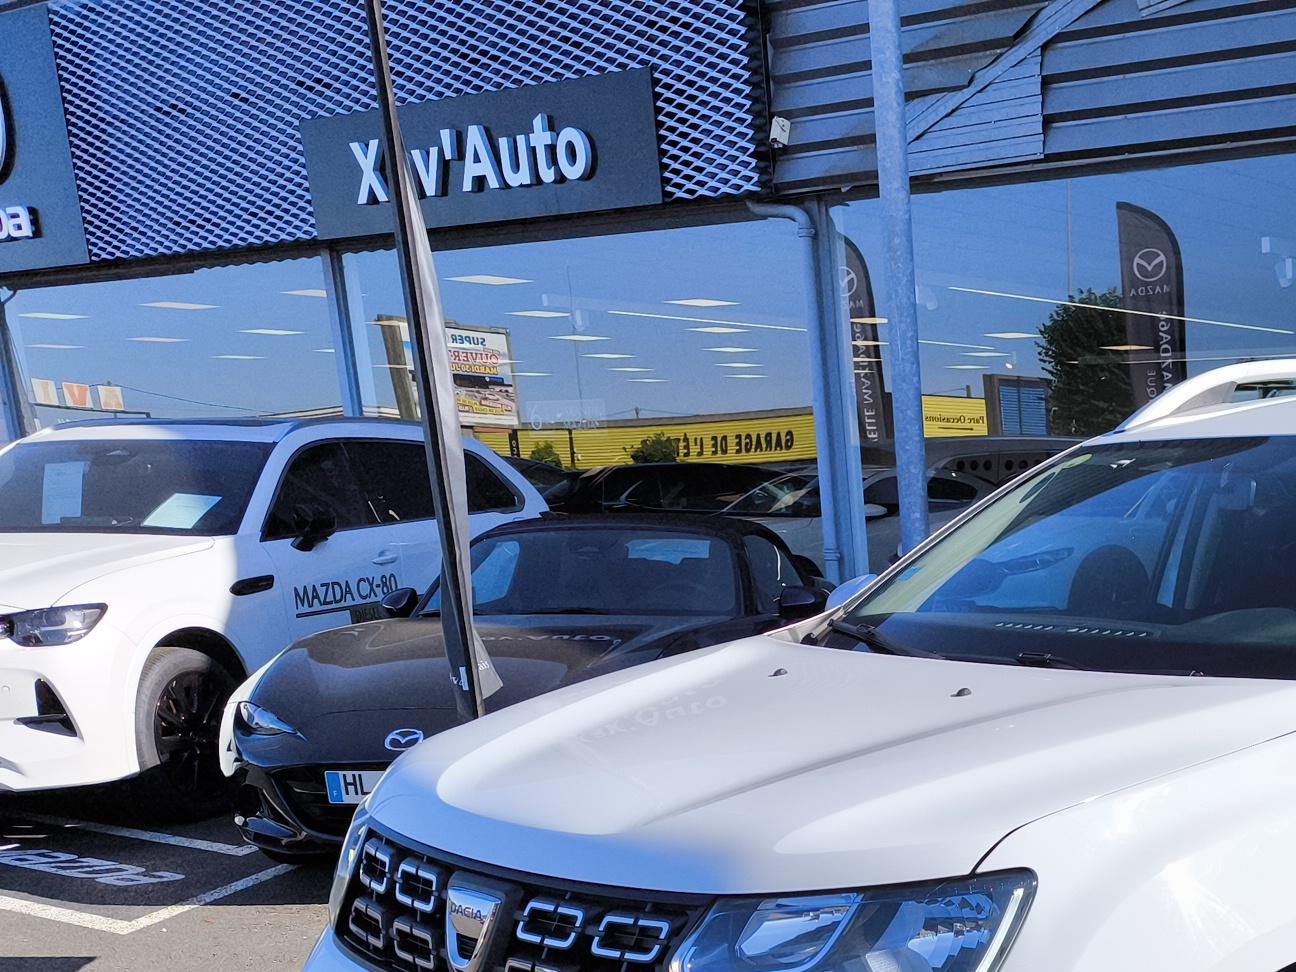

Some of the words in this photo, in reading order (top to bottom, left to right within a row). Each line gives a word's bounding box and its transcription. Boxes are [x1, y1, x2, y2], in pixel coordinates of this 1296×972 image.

[349, 113, 592, 205] Xv'Auto
[294, 580, 355, 609] MAZDA
[356, 573, 398, 600] CX-80
[451, 902, 482, 921] DACIA
